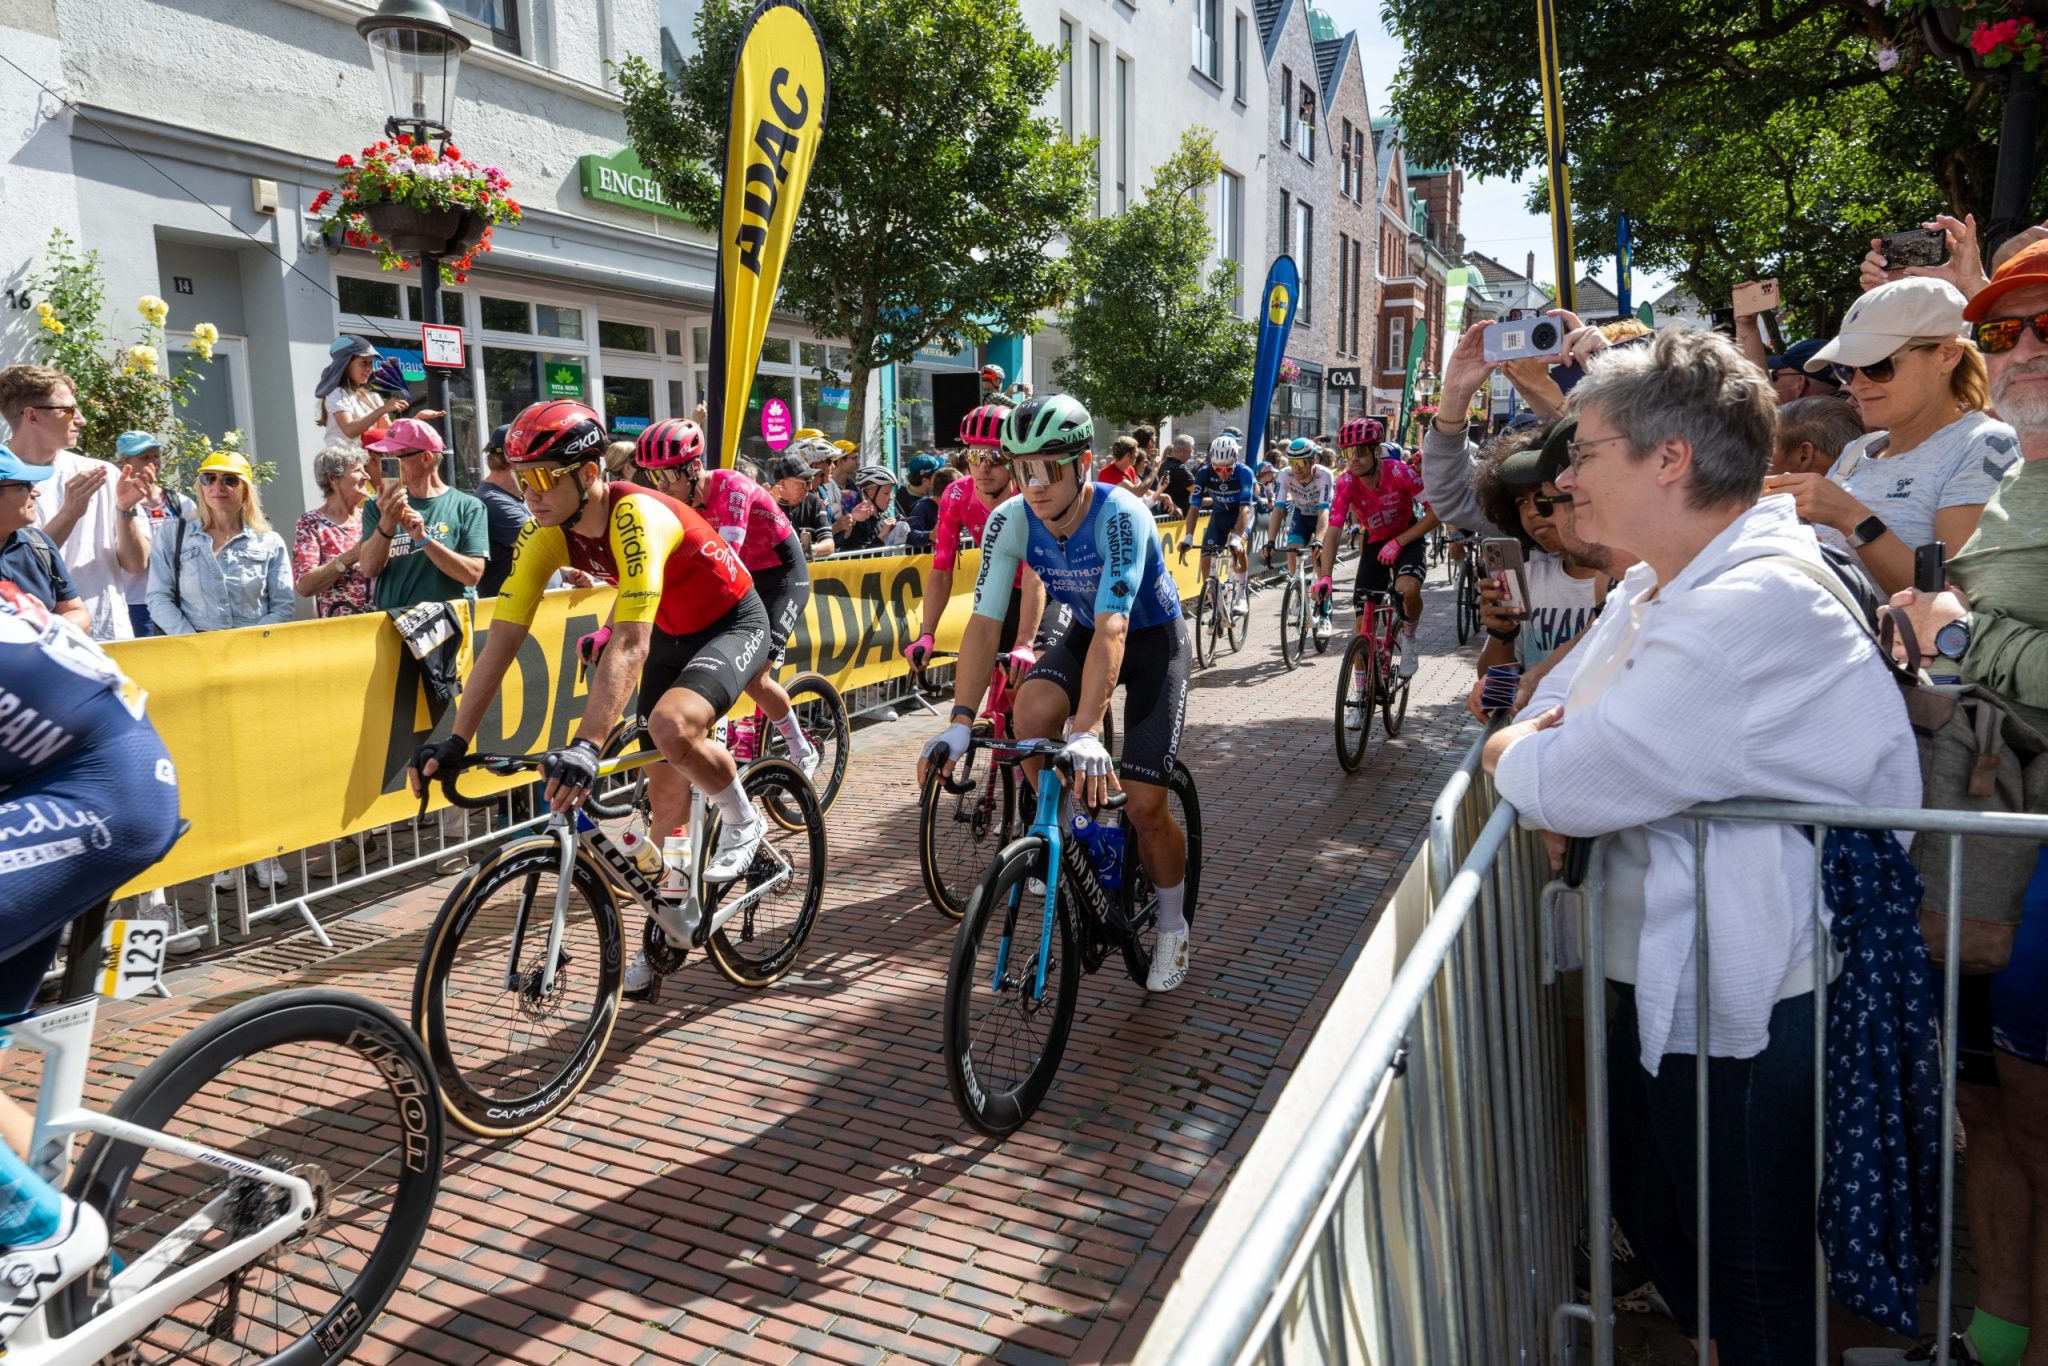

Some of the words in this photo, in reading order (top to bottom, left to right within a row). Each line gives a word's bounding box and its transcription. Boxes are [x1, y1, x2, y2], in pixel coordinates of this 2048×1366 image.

[599, 166, 681, 209] ENGEL
[734, 67, 809, 277] ADAC
[6, 289, 31, 310] 16
[177, 279, 190, 293] 14
[1331, 371, 1355, 386] C&A
[1380, 406, 1395, 415] dm
[1062, 430, 1084, 443] VAN
[616, 502, 648, 578] Cofidis
[977, 513, 1008, 586] DECATHLON
[1106, 515, 1121, 578] MONDIALE
[1118, 512, 1133, 547] AG2R
[389, 547, 410, 558] OUR
[1047, 567, 1103, 577] DECATHLON
[1121, 548, 1133, 567] LA
[770, 566, 923, 684] ADAC
[780, 598, 798, 633] EF
[735, 628, 764, 672] Cofidis
[1041, 668, 1068, 681] RYSEL
[0, 687, 74, 766] RAIN
[1168, 679, 1188, 754] DECATHLON
[1122, 761, 1133, 770] VAN
[1135, 765, 1161, 778] RYSEL
[0, 800, 113, 850] ndly
[591, 833, 659, 914] LOOK
[1066, 834, 1087, 876] VAN
[1082, 868, 1109, 924] RYSEL
[124, 929, 164, 981] 123
[486, 1040, 596, 1119] CAMPAGNOLO
[328, 1301, 363, 1344] 60
